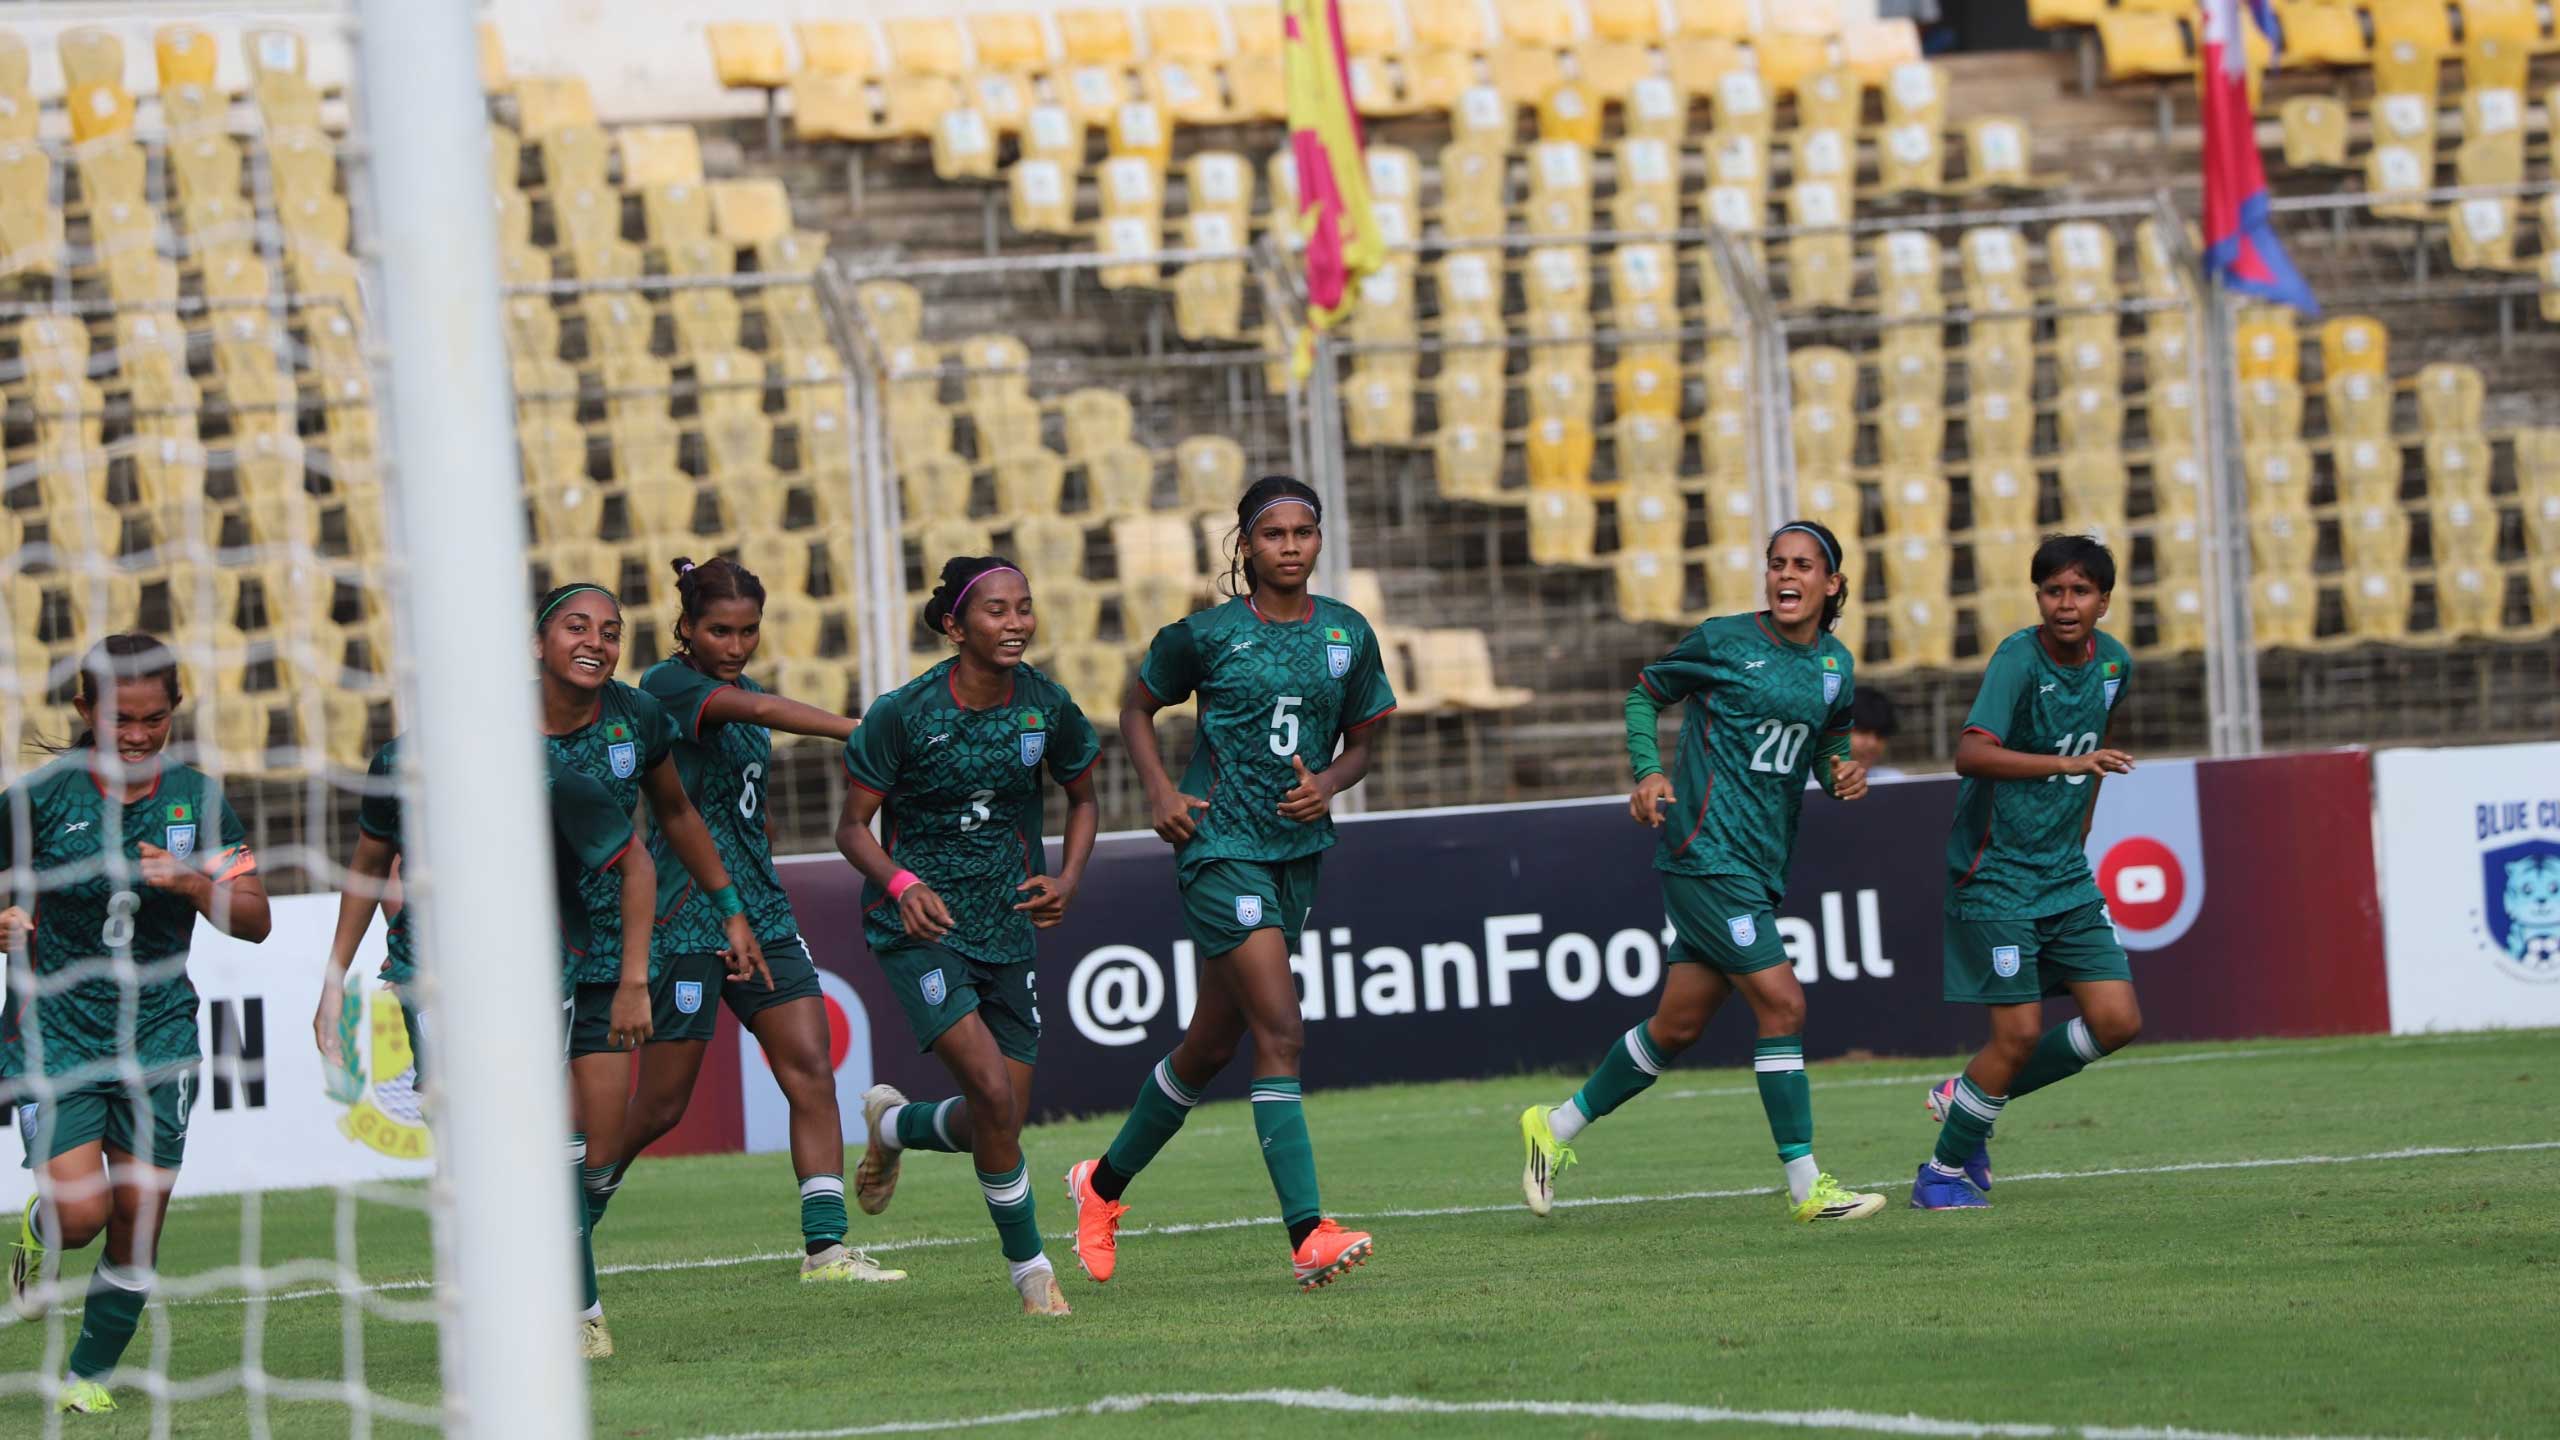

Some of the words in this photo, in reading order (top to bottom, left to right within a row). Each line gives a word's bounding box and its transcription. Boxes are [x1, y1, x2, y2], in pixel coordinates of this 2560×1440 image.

[1268, 696, 1303, 757] 5
[1749, 718, 1810, 775] 20
[2048, 731, 2099, 786] 10
[739, 762, 763, 819] 6
[960, 788, 997, 833] 3
[2476, 801, 2528, 841] BLUE
[102, 890, 142, 948] 8
[1066, 887, 1895, 1047] @IdianFooall
[355, 1111, 421, 1156] GOA
